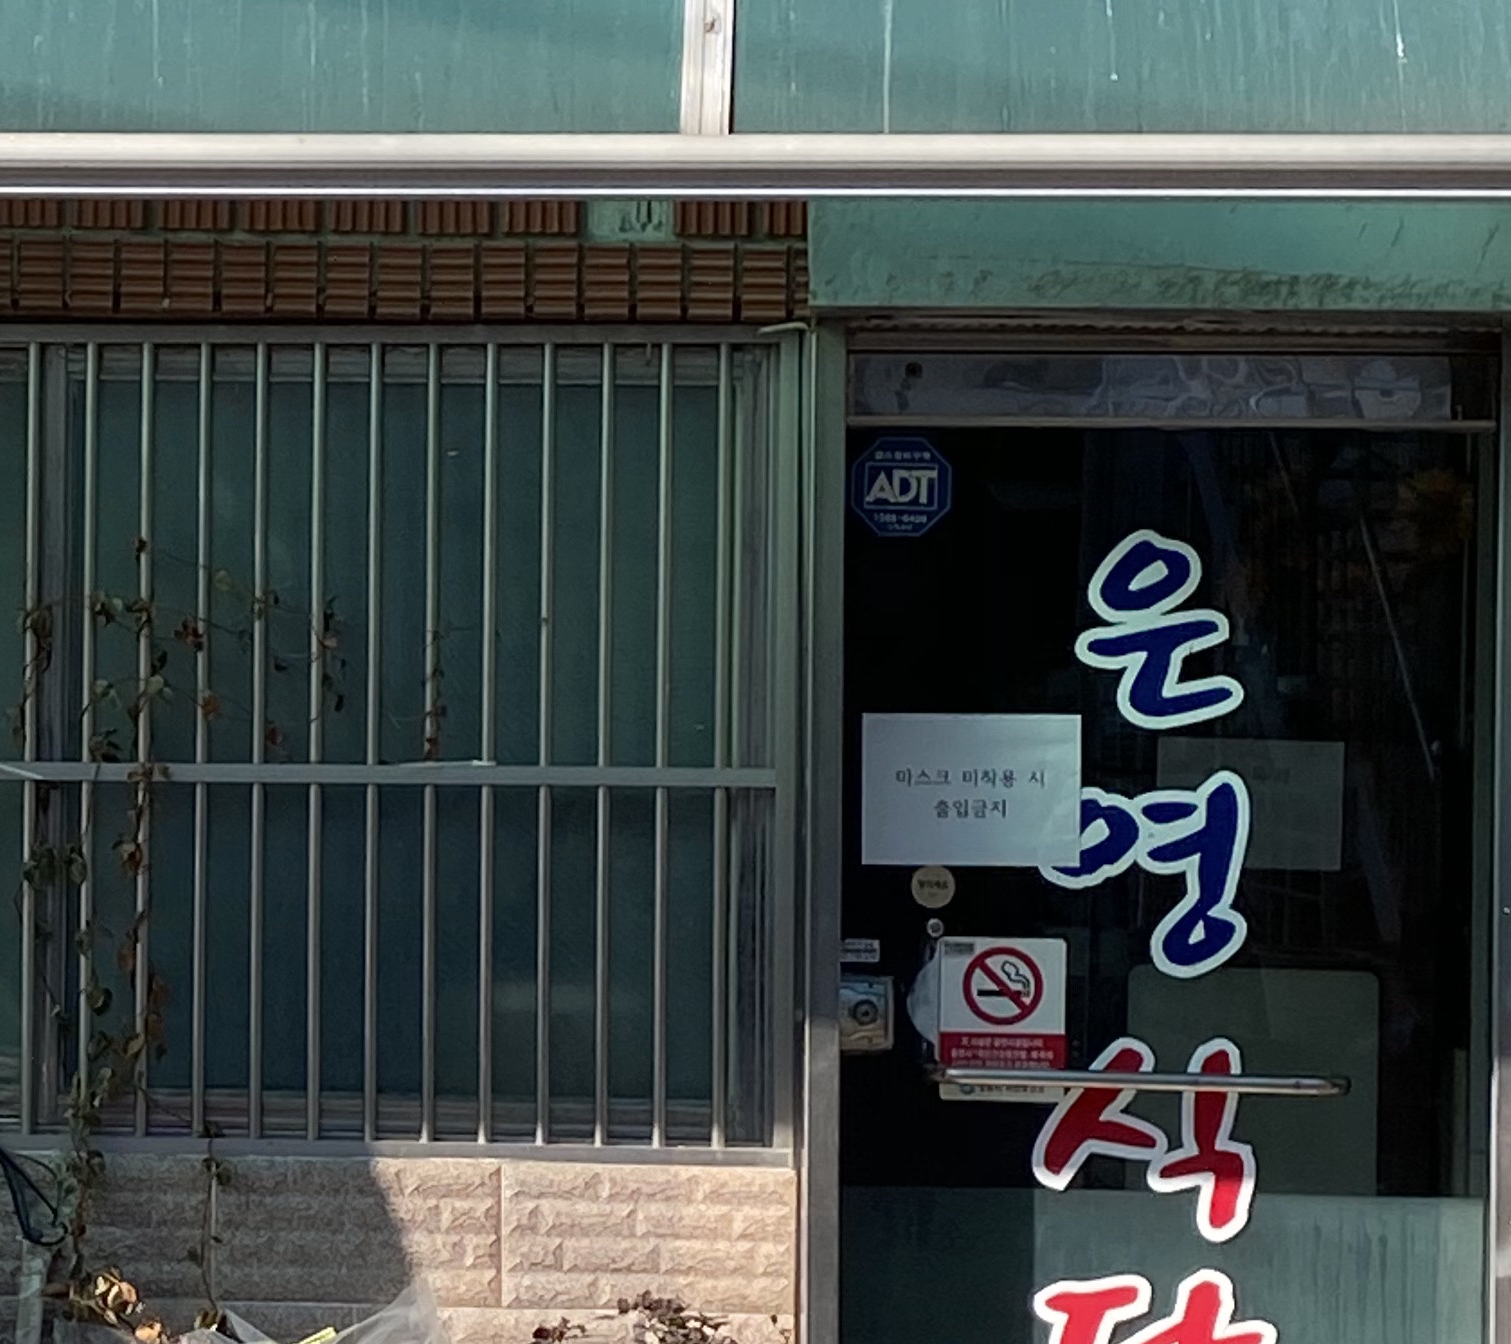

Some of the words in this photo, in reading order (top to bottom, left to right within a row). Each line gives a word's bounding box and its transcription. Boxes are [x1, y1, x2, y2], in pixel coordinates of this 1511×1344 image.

[865, 469, 937, 504] ADT
[895, 768, 952, 787] 마스크
[961, 768, 1017, 788] 미착용
[1028, 769, 1045, 788] 시
[934, 799, 1007, 819] 출입금지
